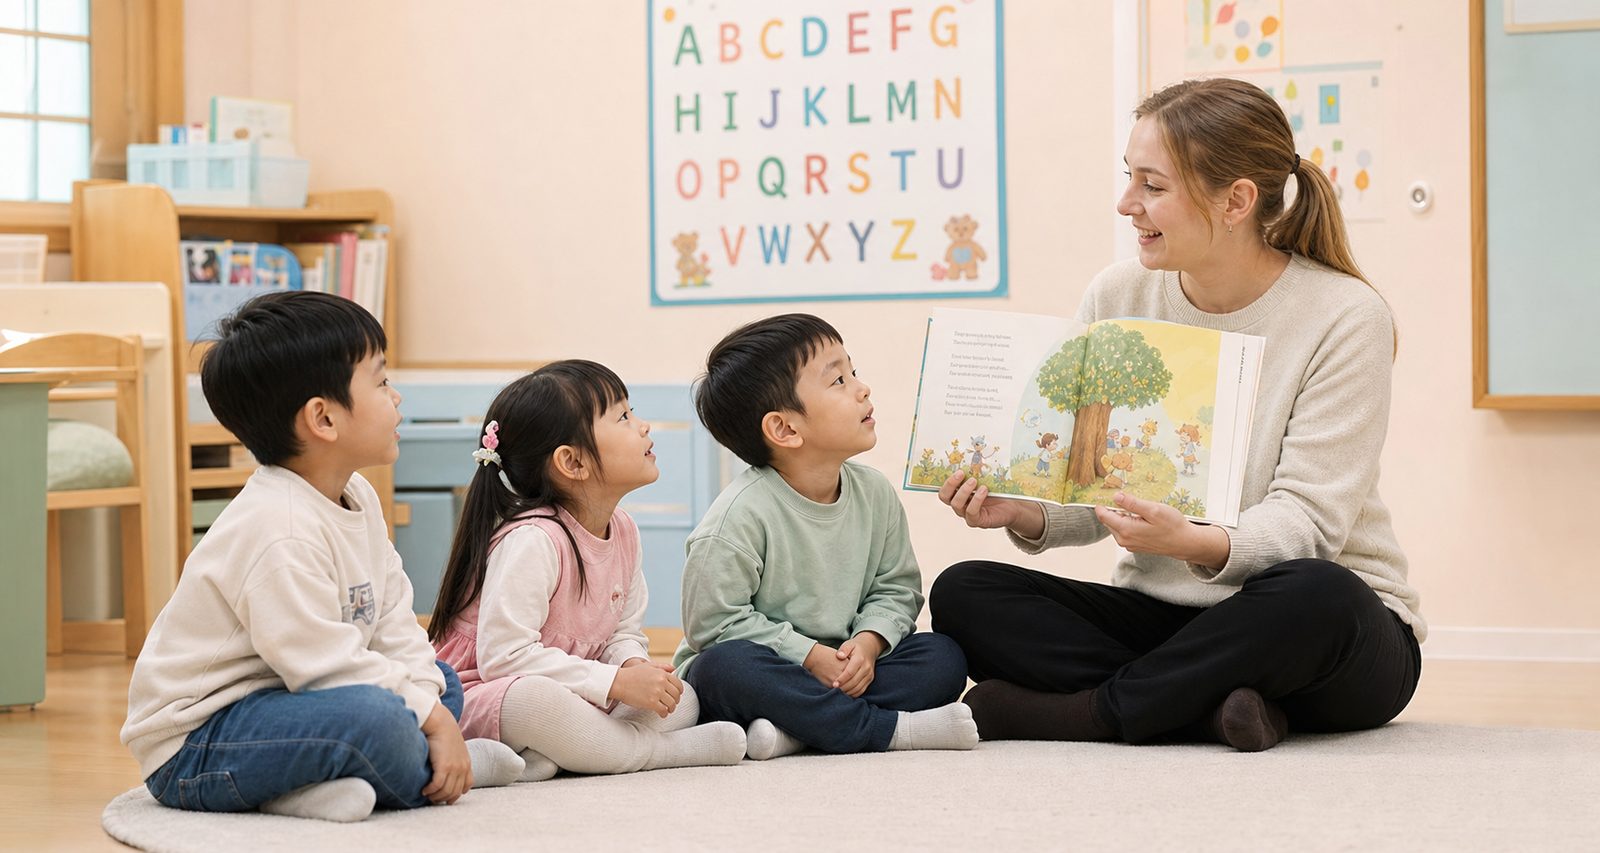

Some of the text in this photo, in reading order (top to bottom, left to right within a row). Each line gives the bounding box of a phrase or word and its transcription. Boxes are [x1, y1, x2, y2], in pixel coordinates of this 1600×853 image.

[674, 5, 958, 66] A B C D E F G
[675, 76, 961, 133] H I J K L M N
[676, 148, 963, 200] O P Q R S T U
[721, 219, 918, 266] V W X Y Z
